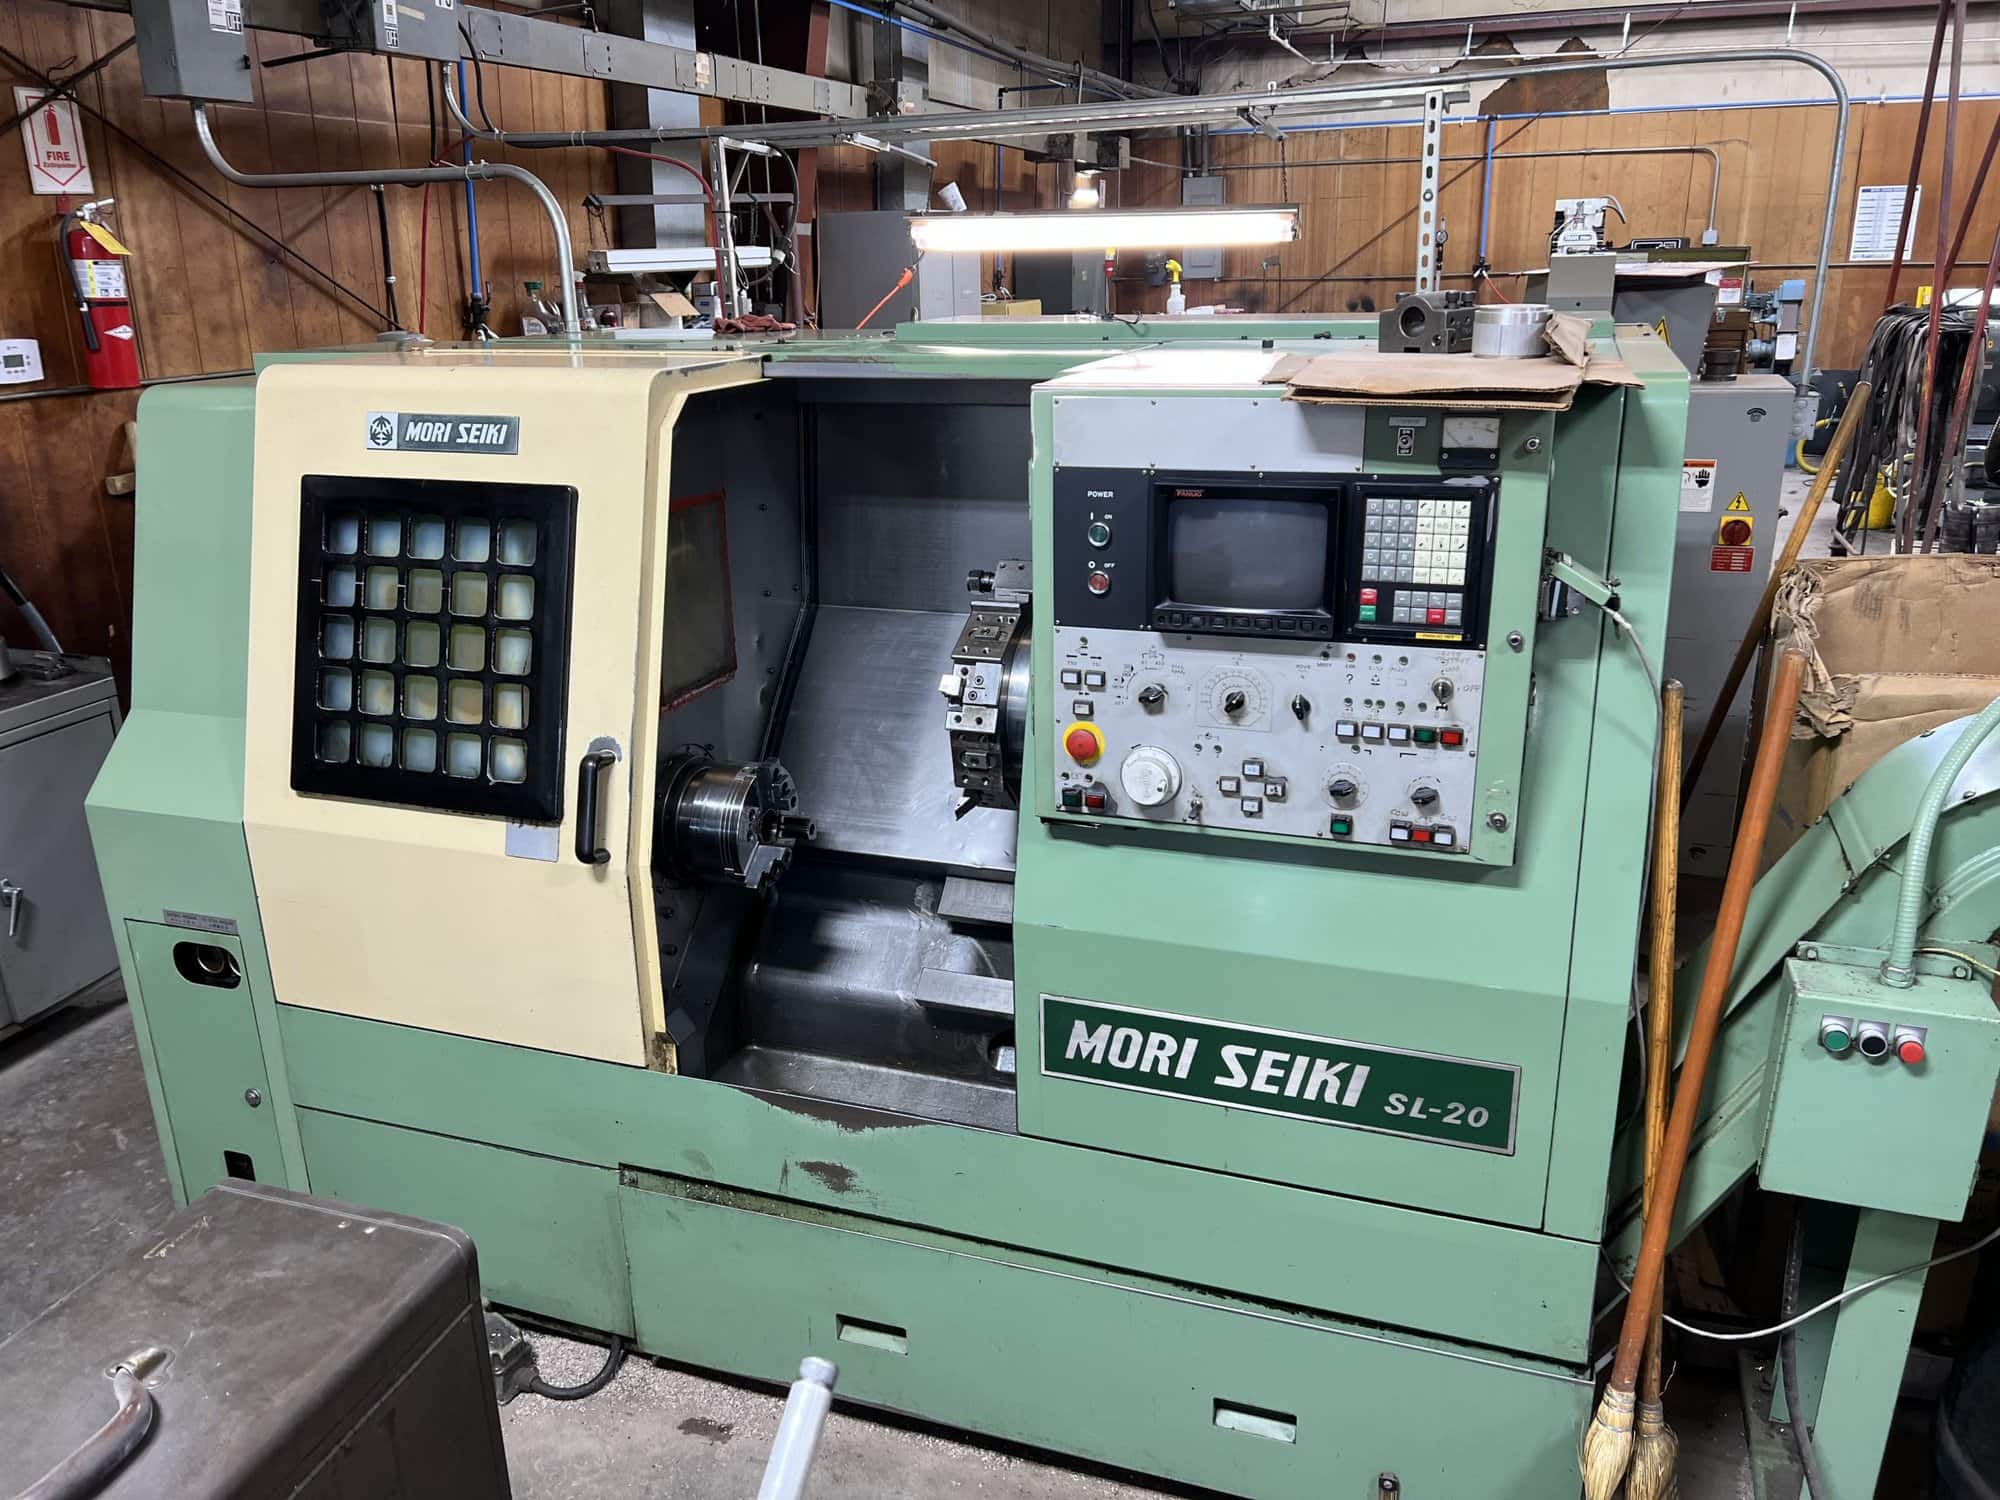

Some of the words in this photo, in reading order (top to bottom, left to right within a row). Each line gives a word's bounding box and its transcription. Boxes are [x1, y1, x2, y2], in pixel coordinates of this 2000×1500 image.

[46, 151, 71, 161] FIRE
[405, 421, 453, 443] MORI
[456, 423, 508, 445] SEIKI
[1087, 490, 1114, 498] POWER
[1064, 1019, 1200, 1079] MORI
[1213, 1043, 1371, 1108] SEIKI
[1383, 1092, 1490, 1128] SL-20
